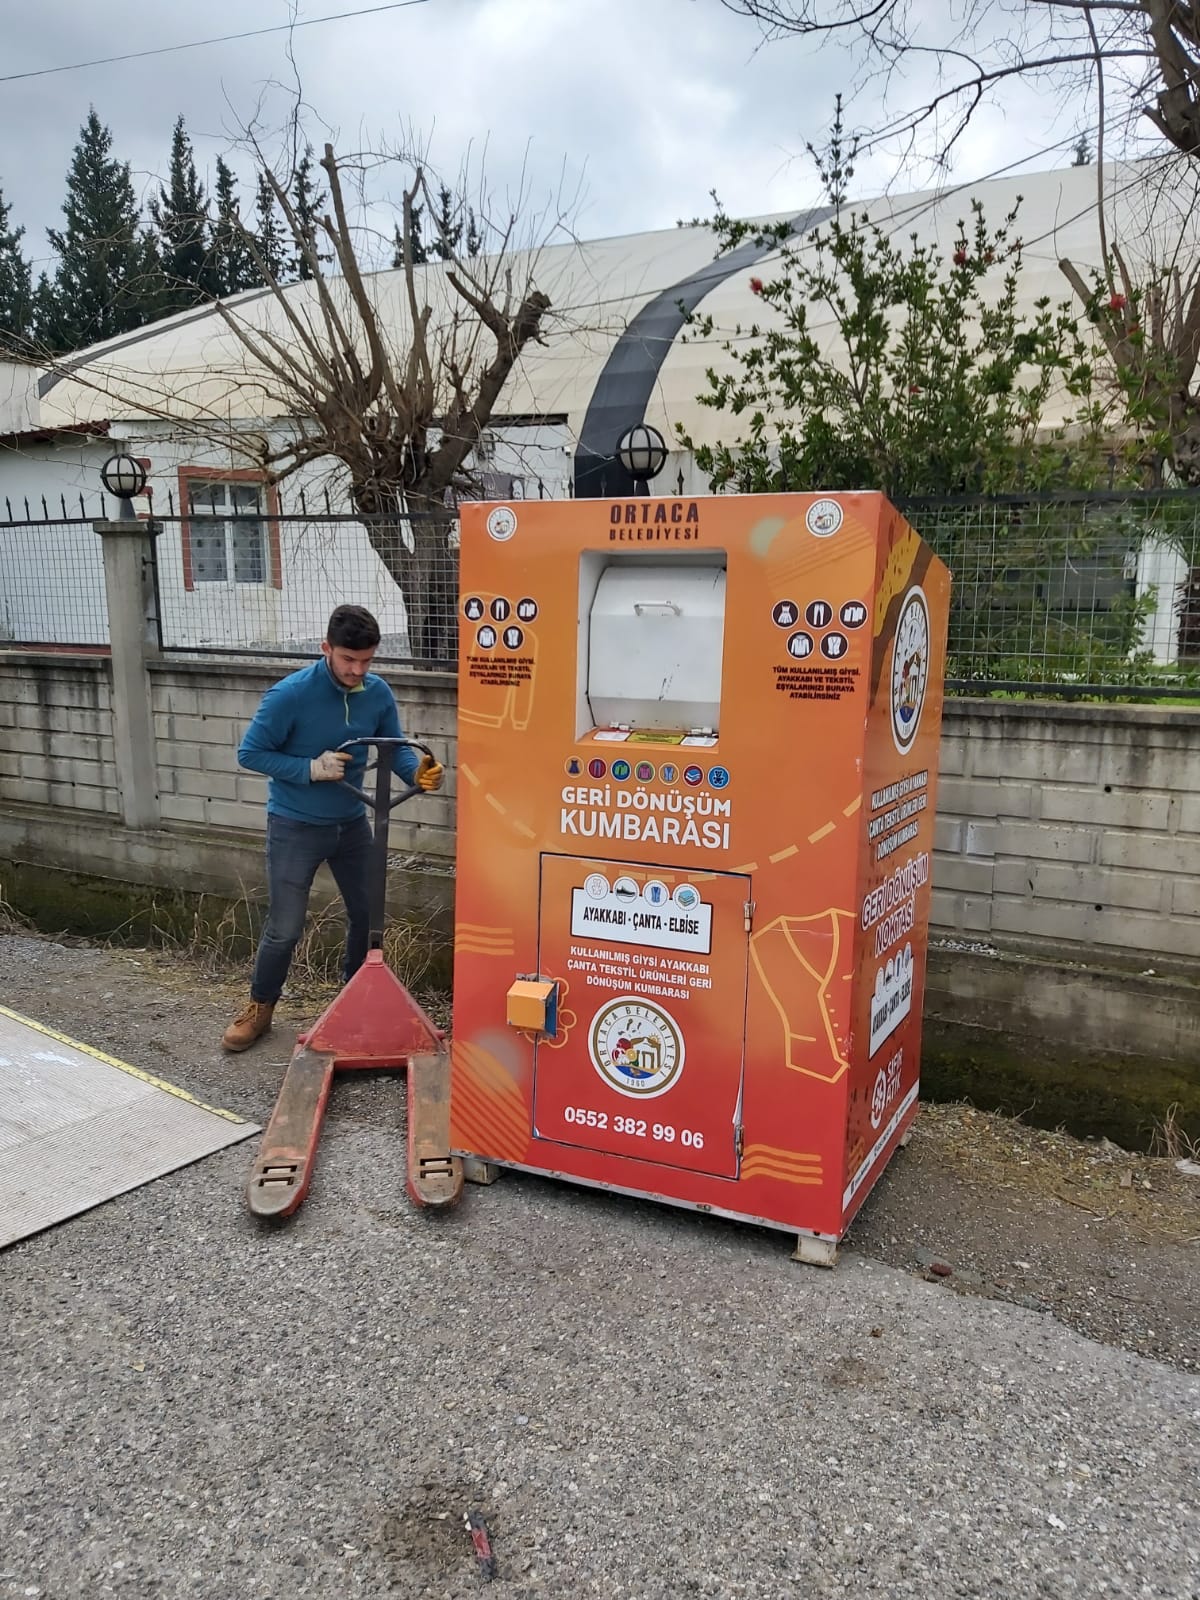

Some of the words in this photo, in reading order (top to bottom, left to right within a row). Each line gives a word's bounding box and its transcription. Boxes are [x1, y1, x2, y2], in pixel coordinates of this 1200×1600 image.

[610, 502, 699, 524] ORTACA
[609, 525, 699, 541] BELEDİYESİ
[773, 665, 788, 673] TÜM
[790, 667, 838, 676] KULLANILMIŞ
[825, 676, 855, 684] TEKSTİL
[776, 683, 824, 691] EŞYALARINIZI
[825, 685, 855, 693] BURAYA
[561, 783, 611, 807] GERİ
[617, 787, 731, 819] DÖNÜŞÜM
[560, 808, 730, 850] KUMBARASI
[861, 876, 887, 932] GERİ
[886, 851, 930, 911] DÖNÜŞÜM
[583, 906, 627, 926] AYAKKABI
[632, 914, 662, 931] ÇANTA
[669, 913, 699, 935] ELBİSE
[567, 959, 597, 973] ÇANTA
[599, 963, 637, 978] TEKSTİL
[639, 968, 687, 985] ÜRÜNLERİ
[689, 976, 712, 989] GERİ
[570, 945, 631, 966] KULLANILMIŞ
[632, 952, 658, 967] GİYSİ
[660, 959, 710, 975] AYAKKABI
[586, 975, 632, 992] DÖNÜŞÜM
[634, 983, 690, 1000] KUMBARASI
[564, 1106, 608, 1129] 0552
[613, 1115, 647, 1137] 382
[652, 1123, 676, 1142] 99
[680, 1129, 704, 1149] 06
